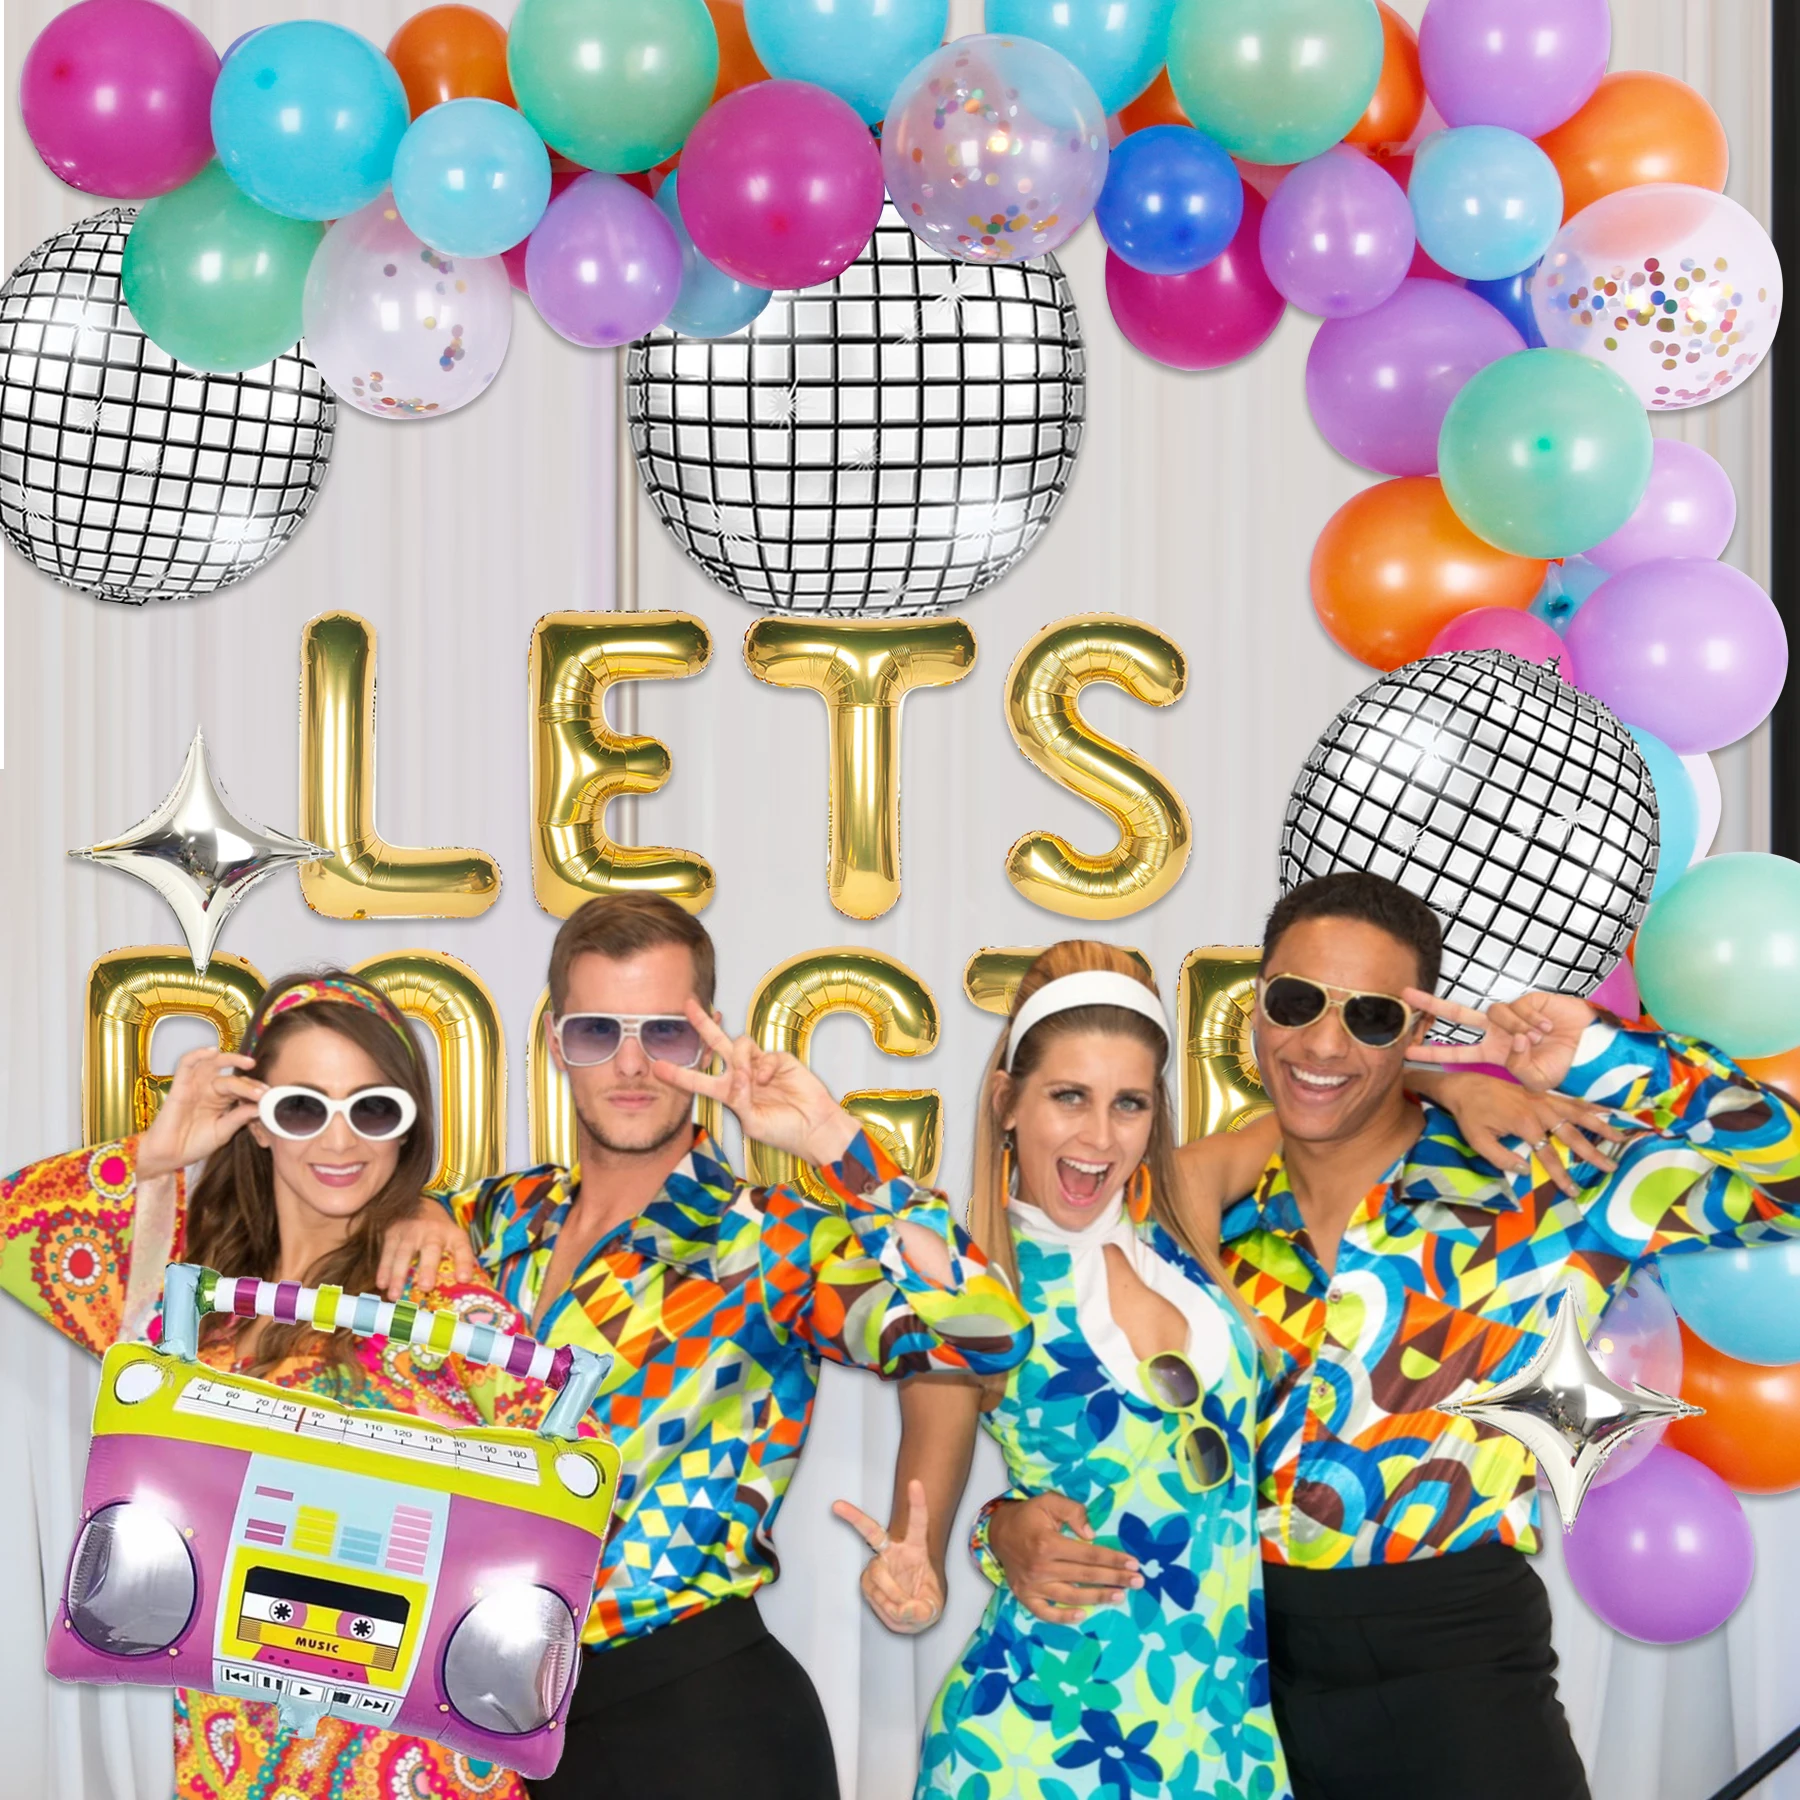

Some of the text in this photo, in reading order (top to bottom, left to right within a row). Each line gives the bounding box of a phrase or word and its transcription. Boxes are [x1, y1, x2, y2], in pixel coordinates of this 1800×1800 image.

[298, 609, 1193, 921] LETS
[197, 1384, 211, 1392] 50
[225, 1391, 240, 1400] 60
[255, 1398, 270, 1407] 70
[282, 1404, 297, 1413] 80
[311, 1411, 326, 1420] 90
[364, 1423, 383, 1432] 110
[394, 1429, 413, 1438] 120
[424, 1435, 443, 1444] 130
[478, 1445, 497, 1454] 150
[508, 1450, 527, 1459] 160
[295, 1636, 339, 1654] MUSIC
